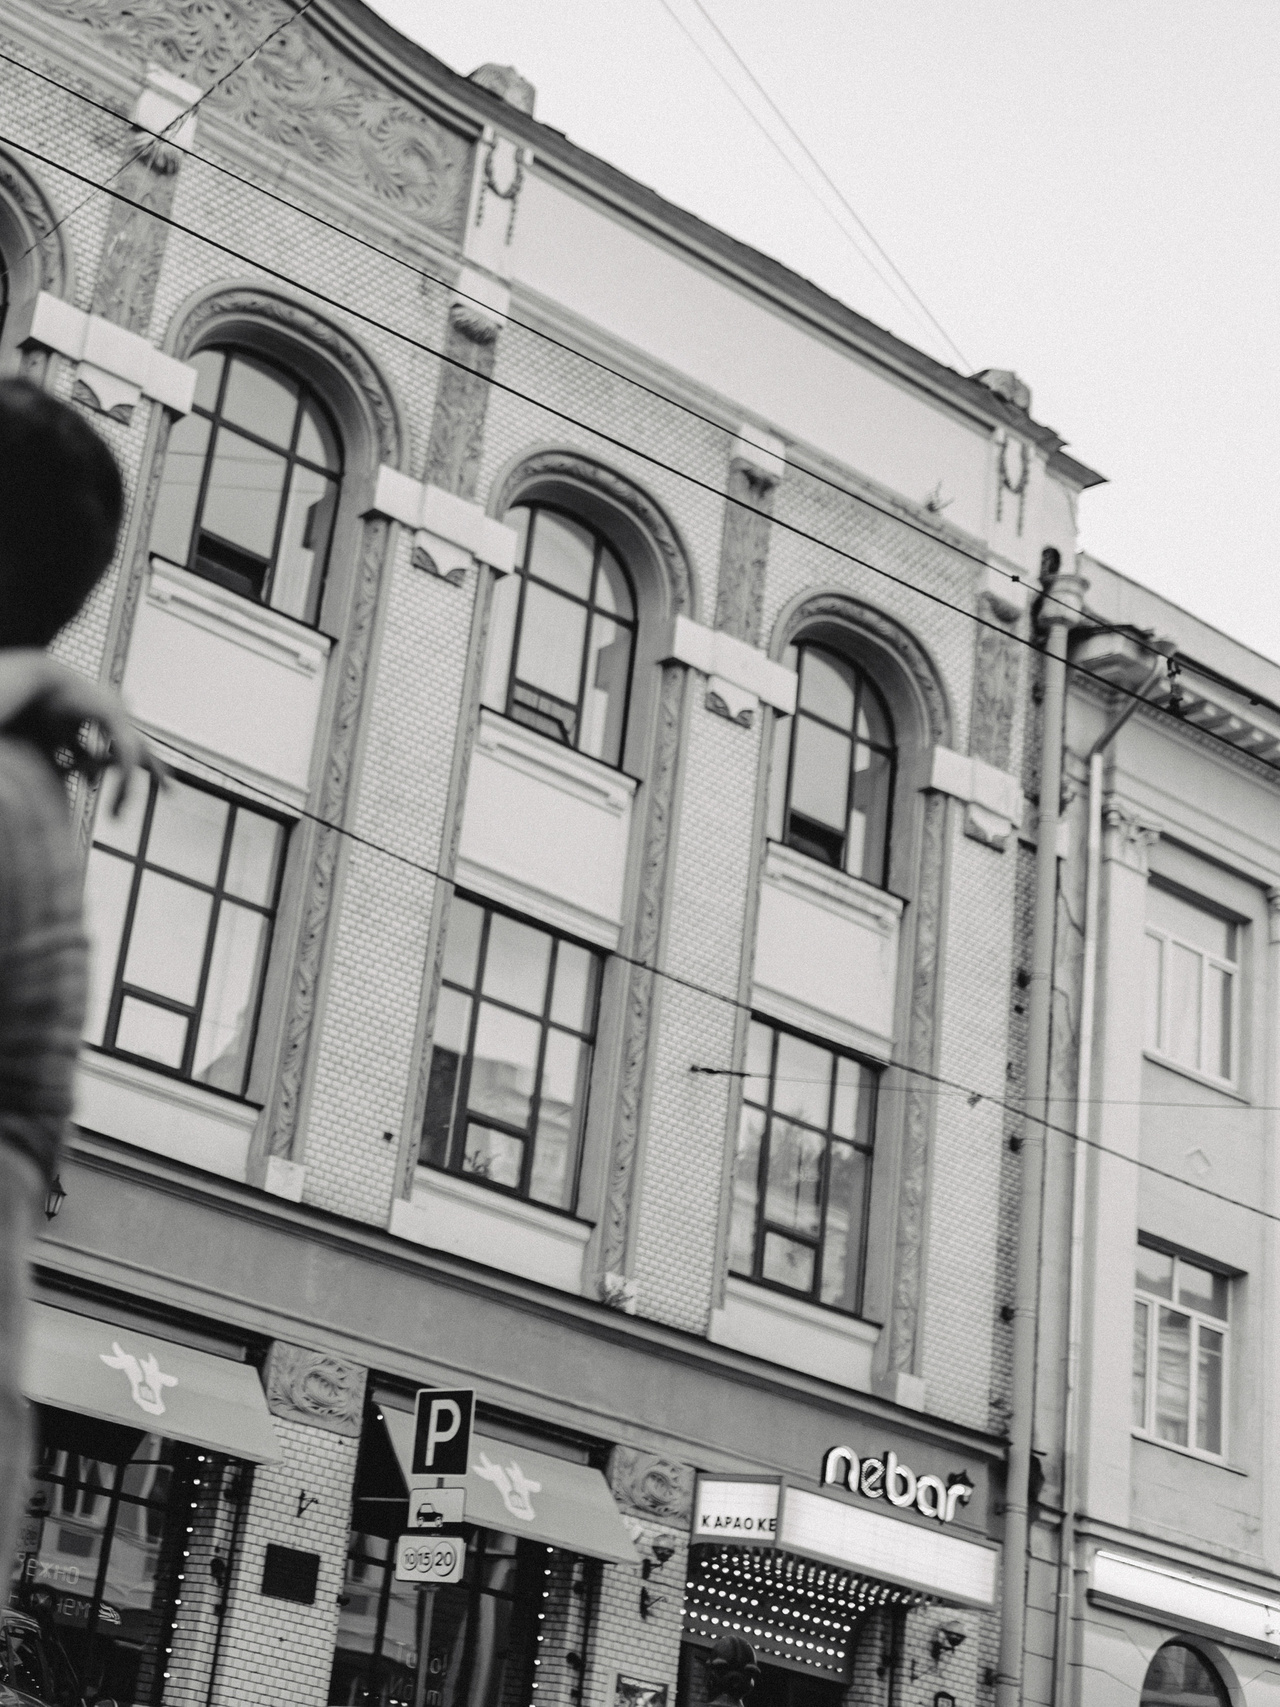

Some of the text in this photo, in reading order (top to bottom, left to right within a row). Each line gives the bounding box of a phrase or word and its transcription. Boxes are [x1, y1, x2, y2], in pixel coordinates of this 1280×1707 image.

[425, 1399, 461, 1466] P
[824, 1446, 972, 1522] nebar
[702, 1515, 777, 1531] КАРАОКЕ
[418, 1552, 431, 1566] 15
[435, 1551, 452, 1566] 20
